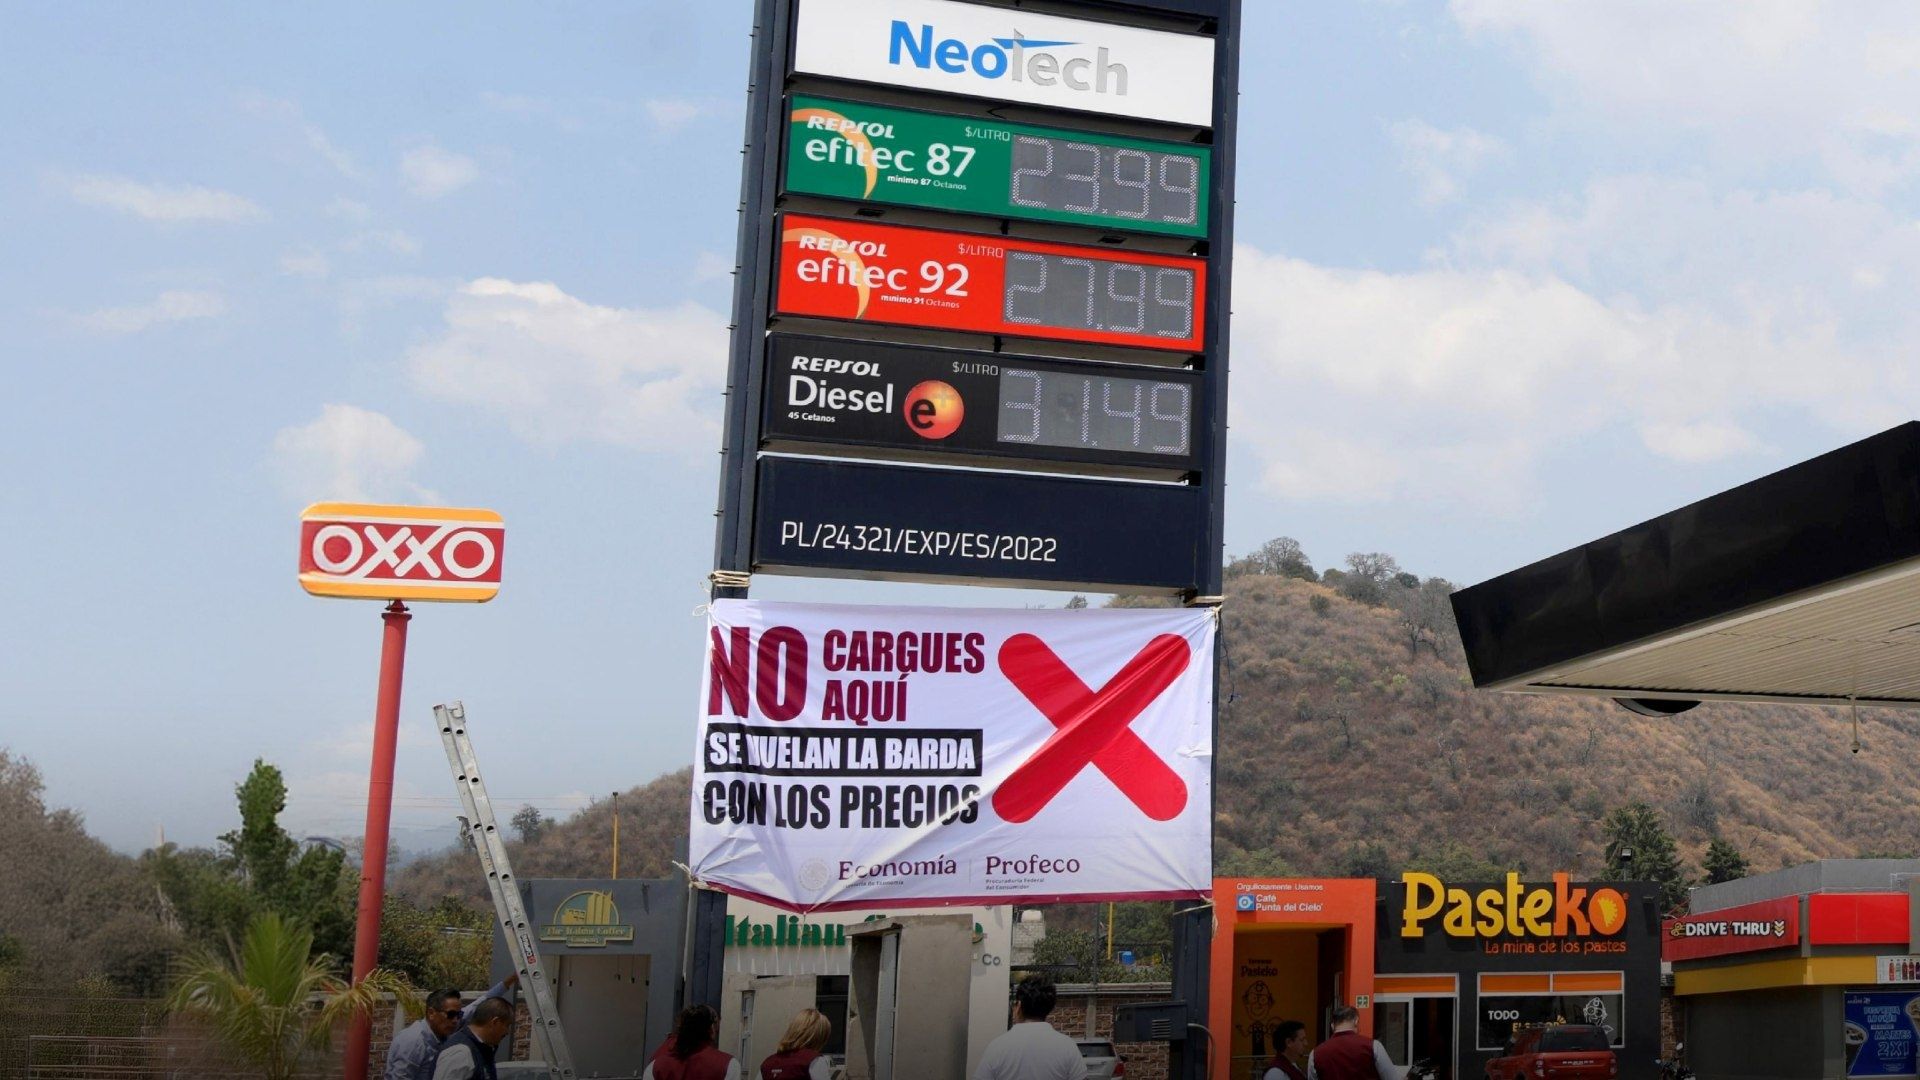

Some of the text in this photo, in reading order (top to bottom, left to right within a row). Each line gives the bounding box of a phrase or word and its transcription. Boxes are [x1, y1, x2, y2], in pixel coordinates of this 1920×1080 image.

[807, 115, 895, 139] REPSOL
[965, 126, 1011, 142] $/LITRO
[805, 137, 976, 178] efitec 87
[920, 177, 932, 186] 87
[933, 179, 967, 191] Octanos
[1012, 136, 1197, 224] 23.99
[799, 235, 888, 258] REPSOL
[958, 243, 1004, 258] $/LITRO
[797, 257, 969, 297] efitec 92
[914, 297, 925, 305] 91
[926, 299, 960, 309] Octanos
[1006, 252, 1193, 340] 27.99
[791, 355, 881, 377] REPSOL
[952, 361, 999, 376] $/LITRO
[788, 374, 894, 414] Diesel
[788, 411, 836, 423] 45 Cetanos
[1003, 369, 1189, 454] 31.49
[312, 523, 495, 579] OXXO
[781, 520, 1057, 562] PL/24321/EXP/ES/2022
[823, 629, 985, 674] CARGUES
[708, 625, 808, 722] NO
[821, 673, 909, 726] AQUÍ
[709, 731, 742, 766] SE
[847, 737, 878, 770] LA
[885, 737, 977, 770] BARDA
[704, 779, 981, 829] CON LOS PRECIOS
[839, 854, 957, 881] Economía
[986, 854, 1080, 875] Profeco
[1236, 882, 1324, 892] Orgullosamente Usamos
[1256, 893, 1277, 903] Café
[1256, 903, 1322, 912] Punta del Cielo
[1401, 871, 1627, 937] Pasteko
[1685, 921, 1771, 936] DRIVE THRU
[1485, 939, 1627, 956] La mina de los pastes
[1487, 1010, 1520, 1020] TODO
